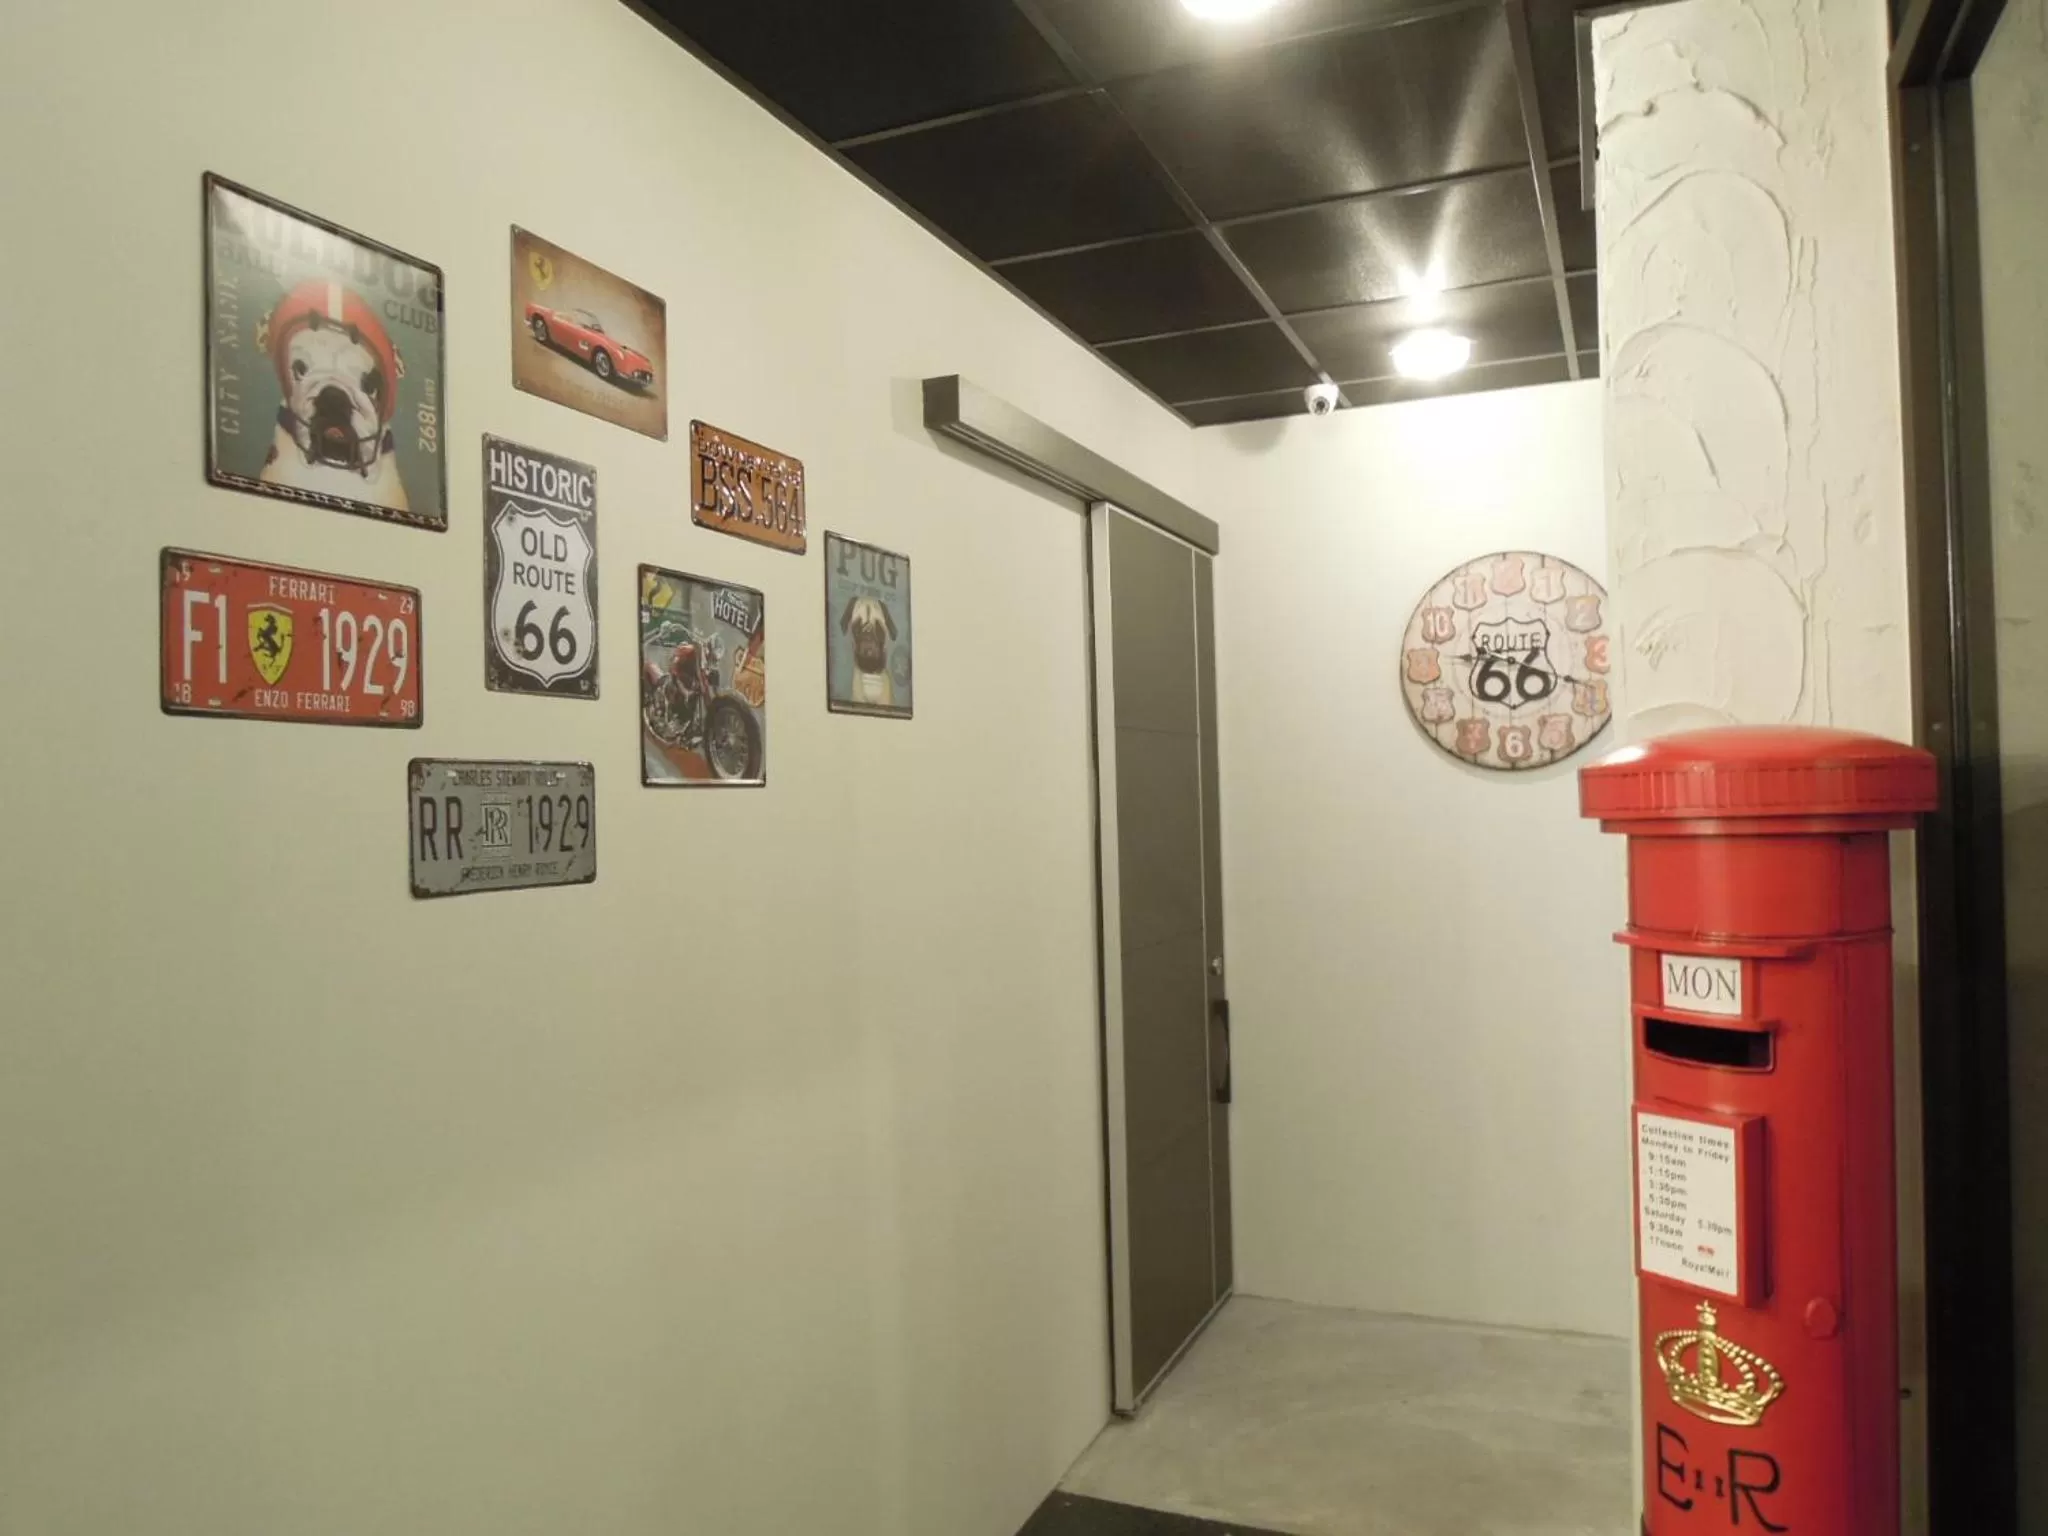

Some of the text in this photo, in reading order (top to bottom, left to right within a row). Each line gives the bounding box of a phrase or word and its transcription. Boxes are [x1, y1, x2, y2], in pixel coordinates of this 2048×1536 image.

[384, 299, 437, 333] CLUB
[219, 368, 240, 435] CITY
[416, 403, 437, 453] 1892
[490, 447, 593, 507] HISTORIC
[520, 527, 568, 562] OLD
[513, 562, 577, 595] ROUTE
[836, 541, 899, 588] PUG
[268, 575, 337, 605] FERRARI
[714, 596, 753, 633] HOTEL
[1426, 610, 1449, 635] 10
[183, 590, 408, 695] F1 1929
[515, 600, 577, 665] 66
[1481, 631, 1542, 649] ROUTE
[1475, 646, 1552, 702] 66
[254, 688, 351, 713] ENZO FERRARI
[1504, 729, 1523, 758] 6
[419, 796, 464, 862] RR
[526, 794, 590, 854] 1929
[1668, 963, 1738, 1001] MON
[1641, 1123, 1731, 1151] Collection times
[1641, 1136, 1679, 1153] Monday
[1697, 1147, 1731, 1164] Friday
[1643, 1205, 1686, 1226] Saturday
